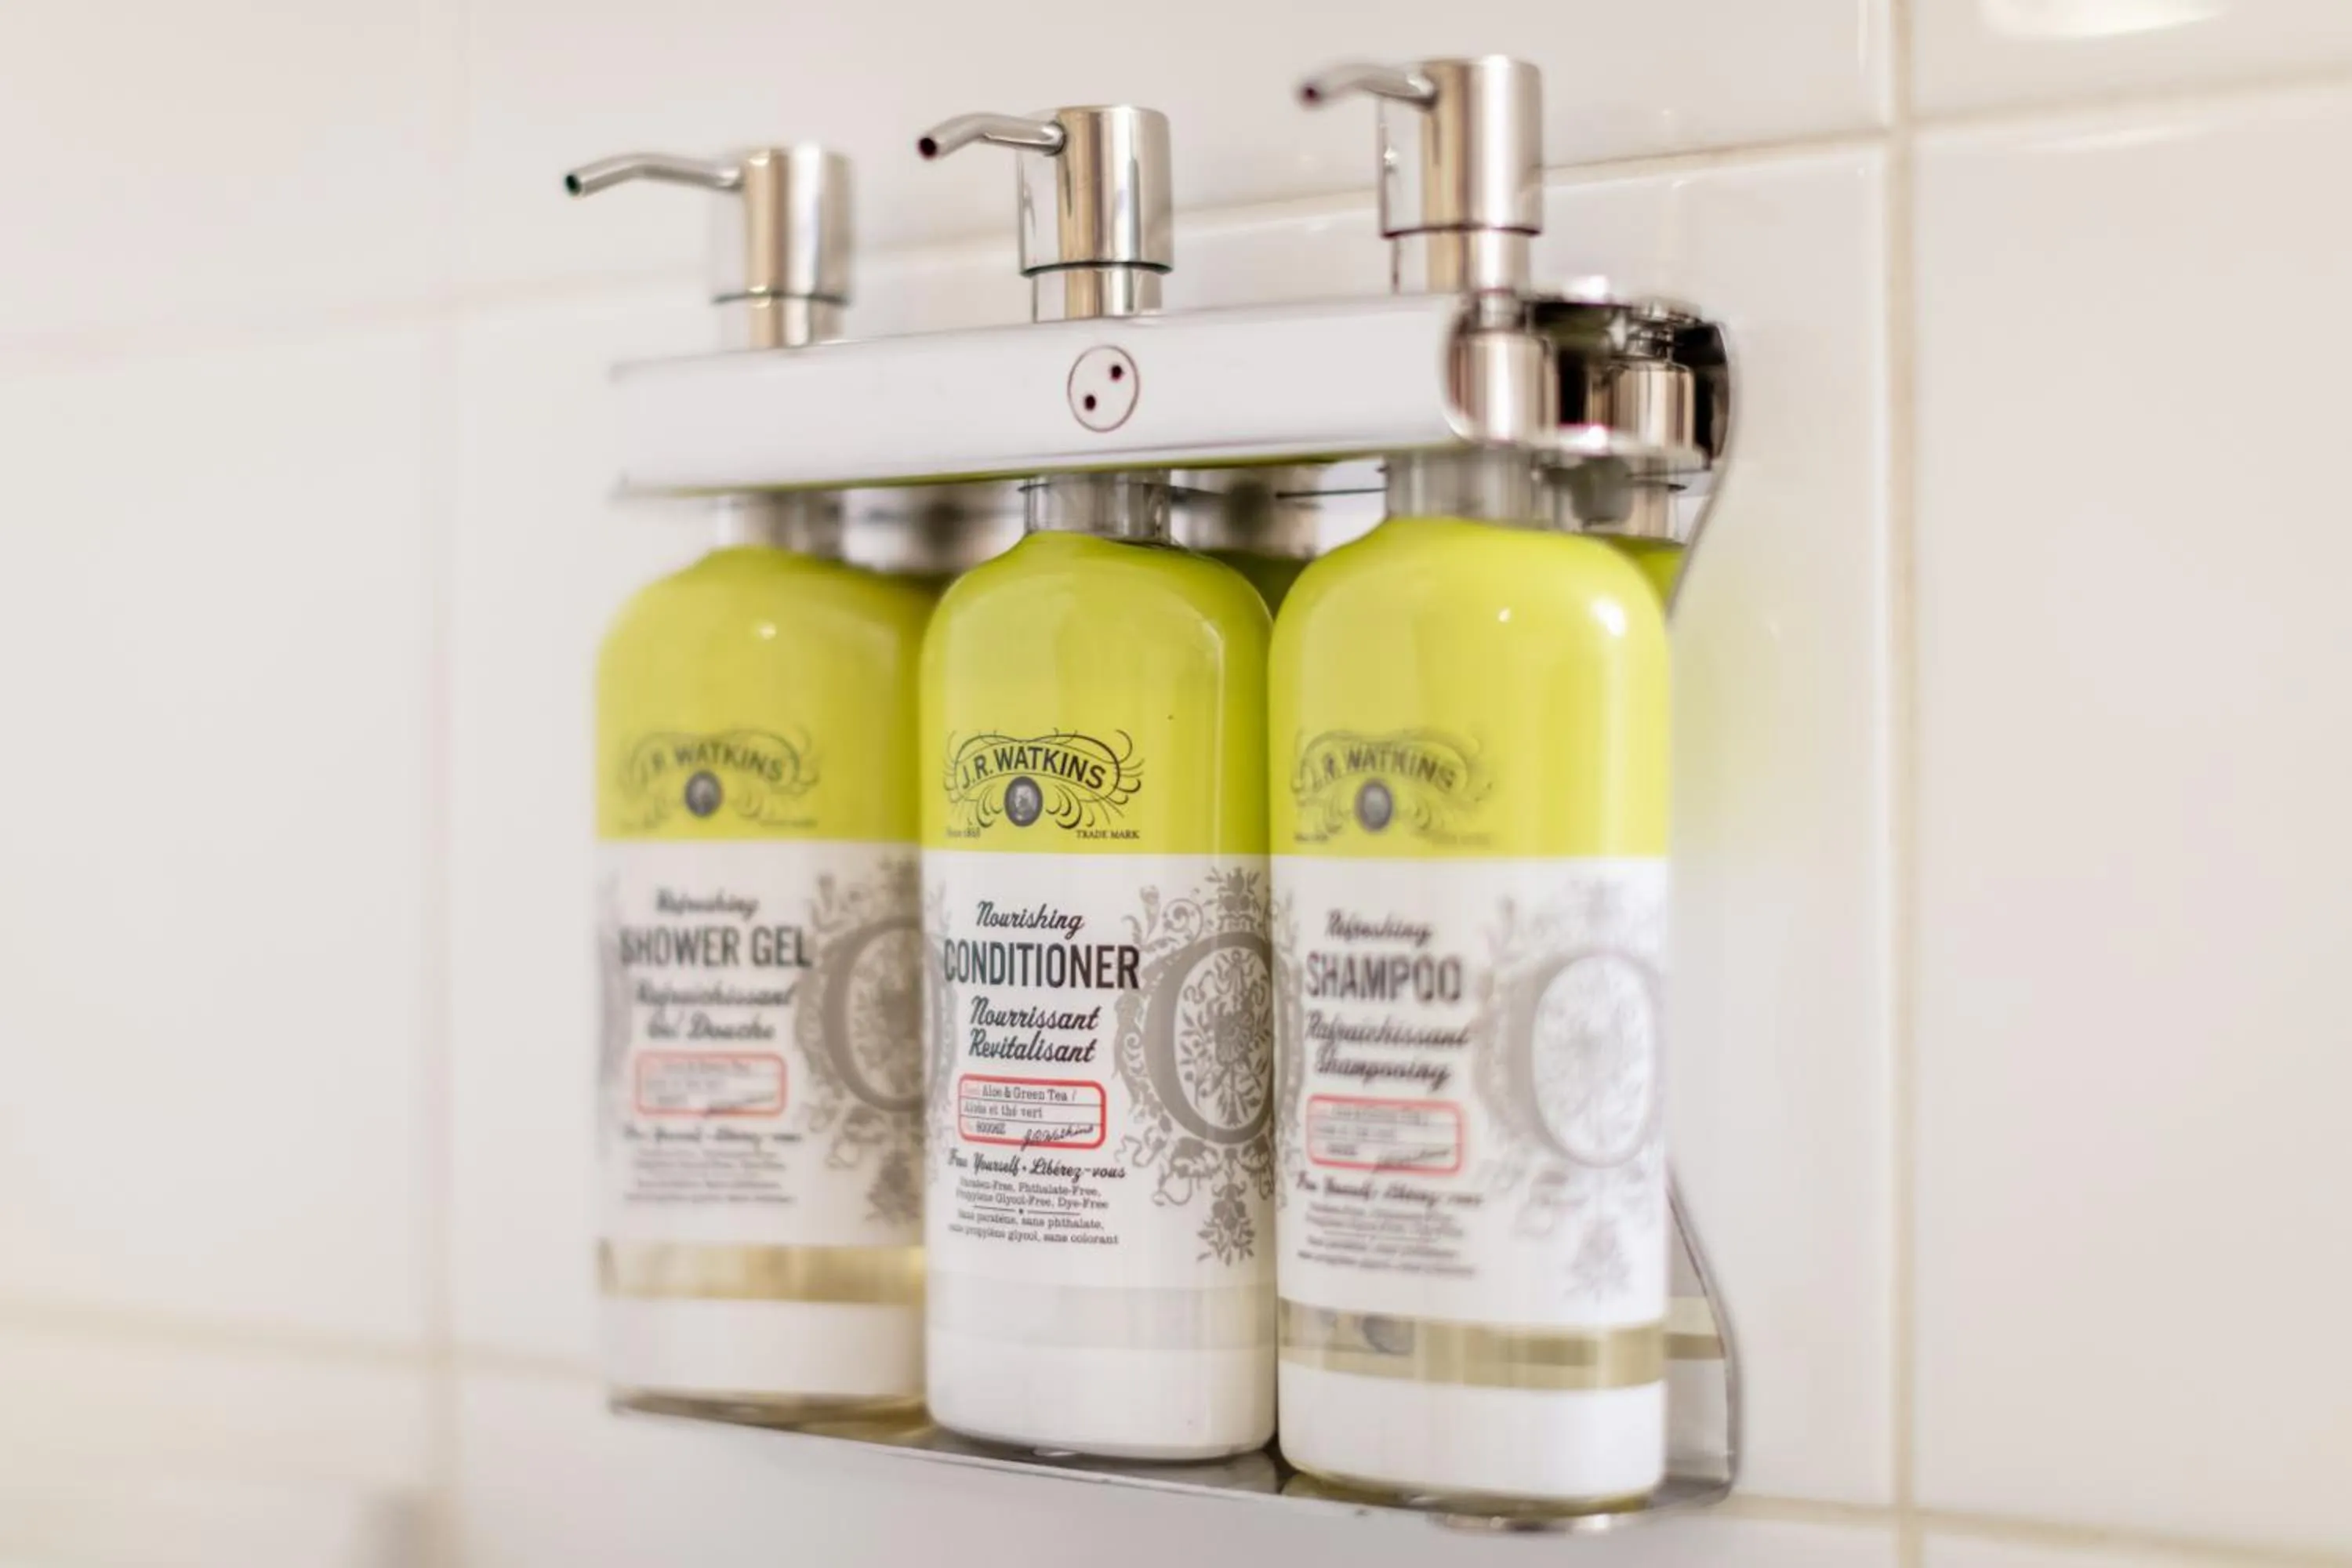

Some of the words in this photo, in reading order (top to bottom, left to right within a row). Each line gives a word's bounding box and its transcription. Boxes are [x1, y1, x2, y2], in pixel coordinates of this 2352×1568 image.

[995, 746, 1106, 789] WATKINS
[1110, 830, 1140, 840] MARK
[976, 901, 1085, 940] Nourishing
[619, 925, 741, 967] SHOWER
[750, 925, 813, 968] GEL
[943, 939, 1140, 989] CONDITIONER
[1306, 951, 1462, 1003] SHAMPOO
[970, 995, 1102, 1030] Nourrissant
[968, 1028, 1098, 1062] Revitalisant
[1013, 1087, 1046, 1100] Green
[1047, 1088, 1068, 1102] Tea
[1022, 1106, 1044, 1119] vert
[1070, 1232, 1120, 1245] colorant
